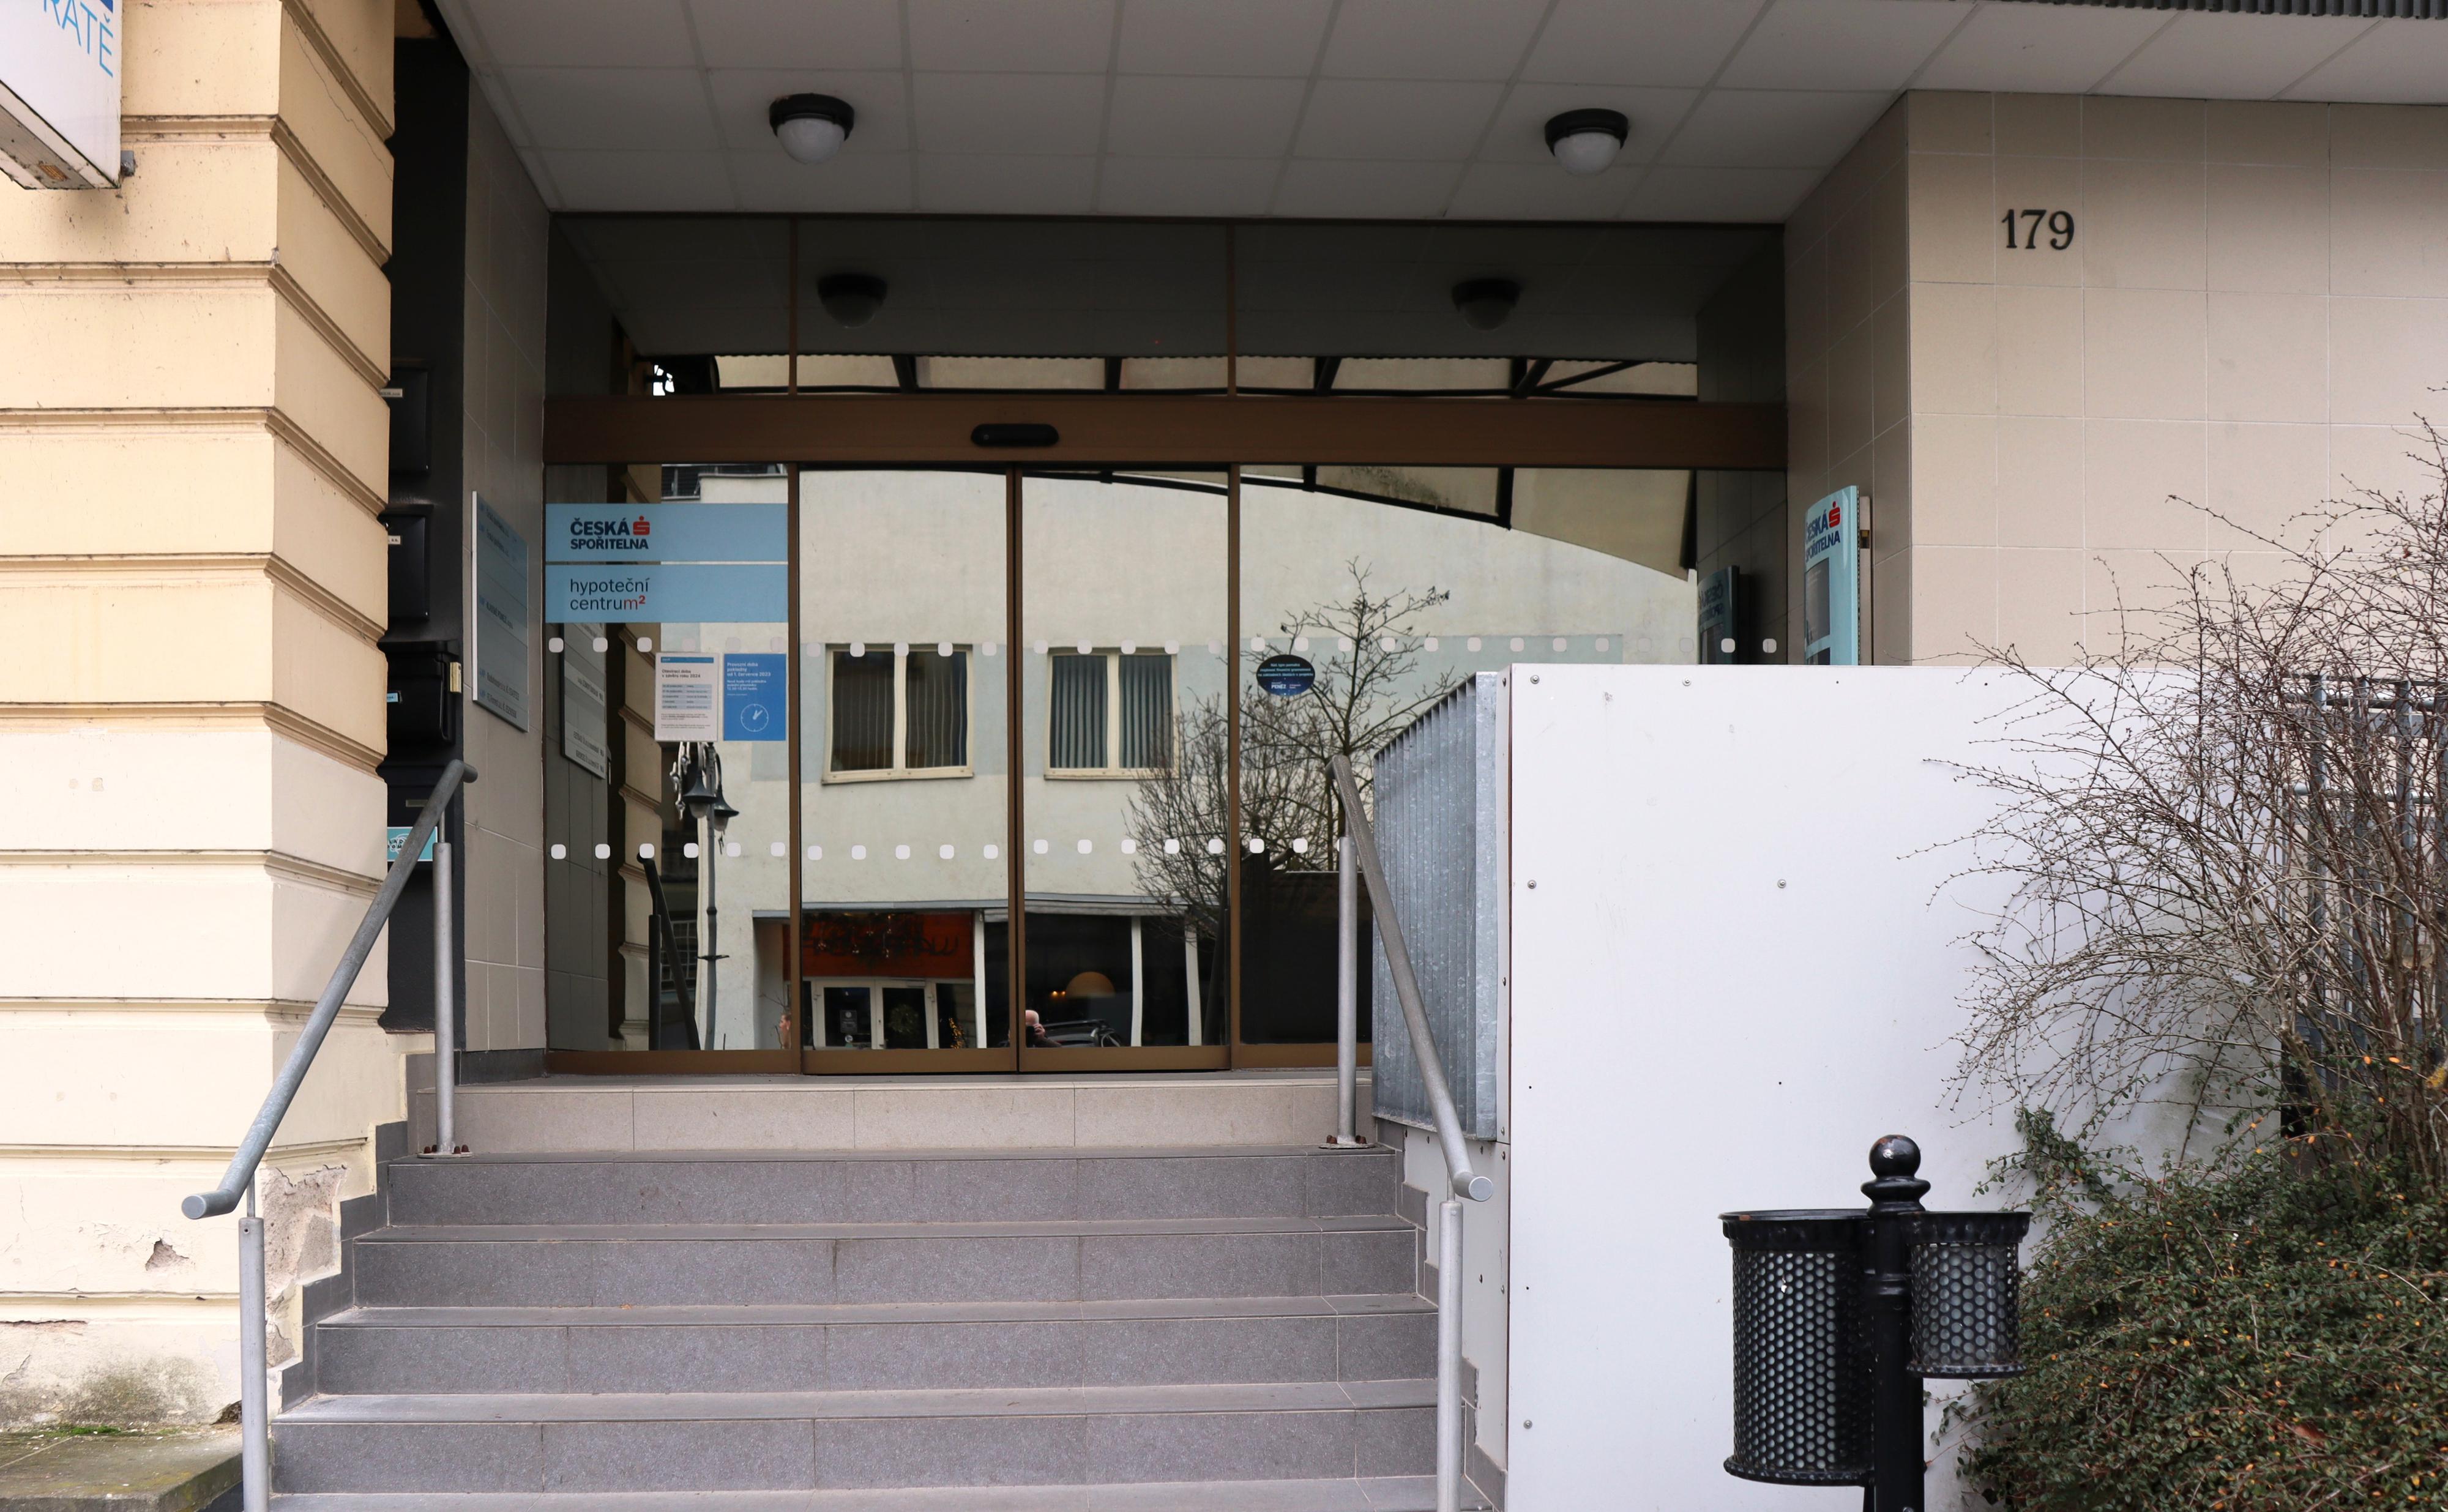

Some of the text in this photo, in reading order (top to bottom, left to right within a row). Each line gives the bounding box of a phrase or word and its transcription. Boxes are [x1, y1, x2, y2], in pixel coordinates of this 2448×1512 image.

[2001, 209, 2075, 250] 179
[570, 518, 630, 536] ČESKÁ
[570, 536, 649, 549] SPOŘITELNA
[570, 578, 650, 596] hypoteční
